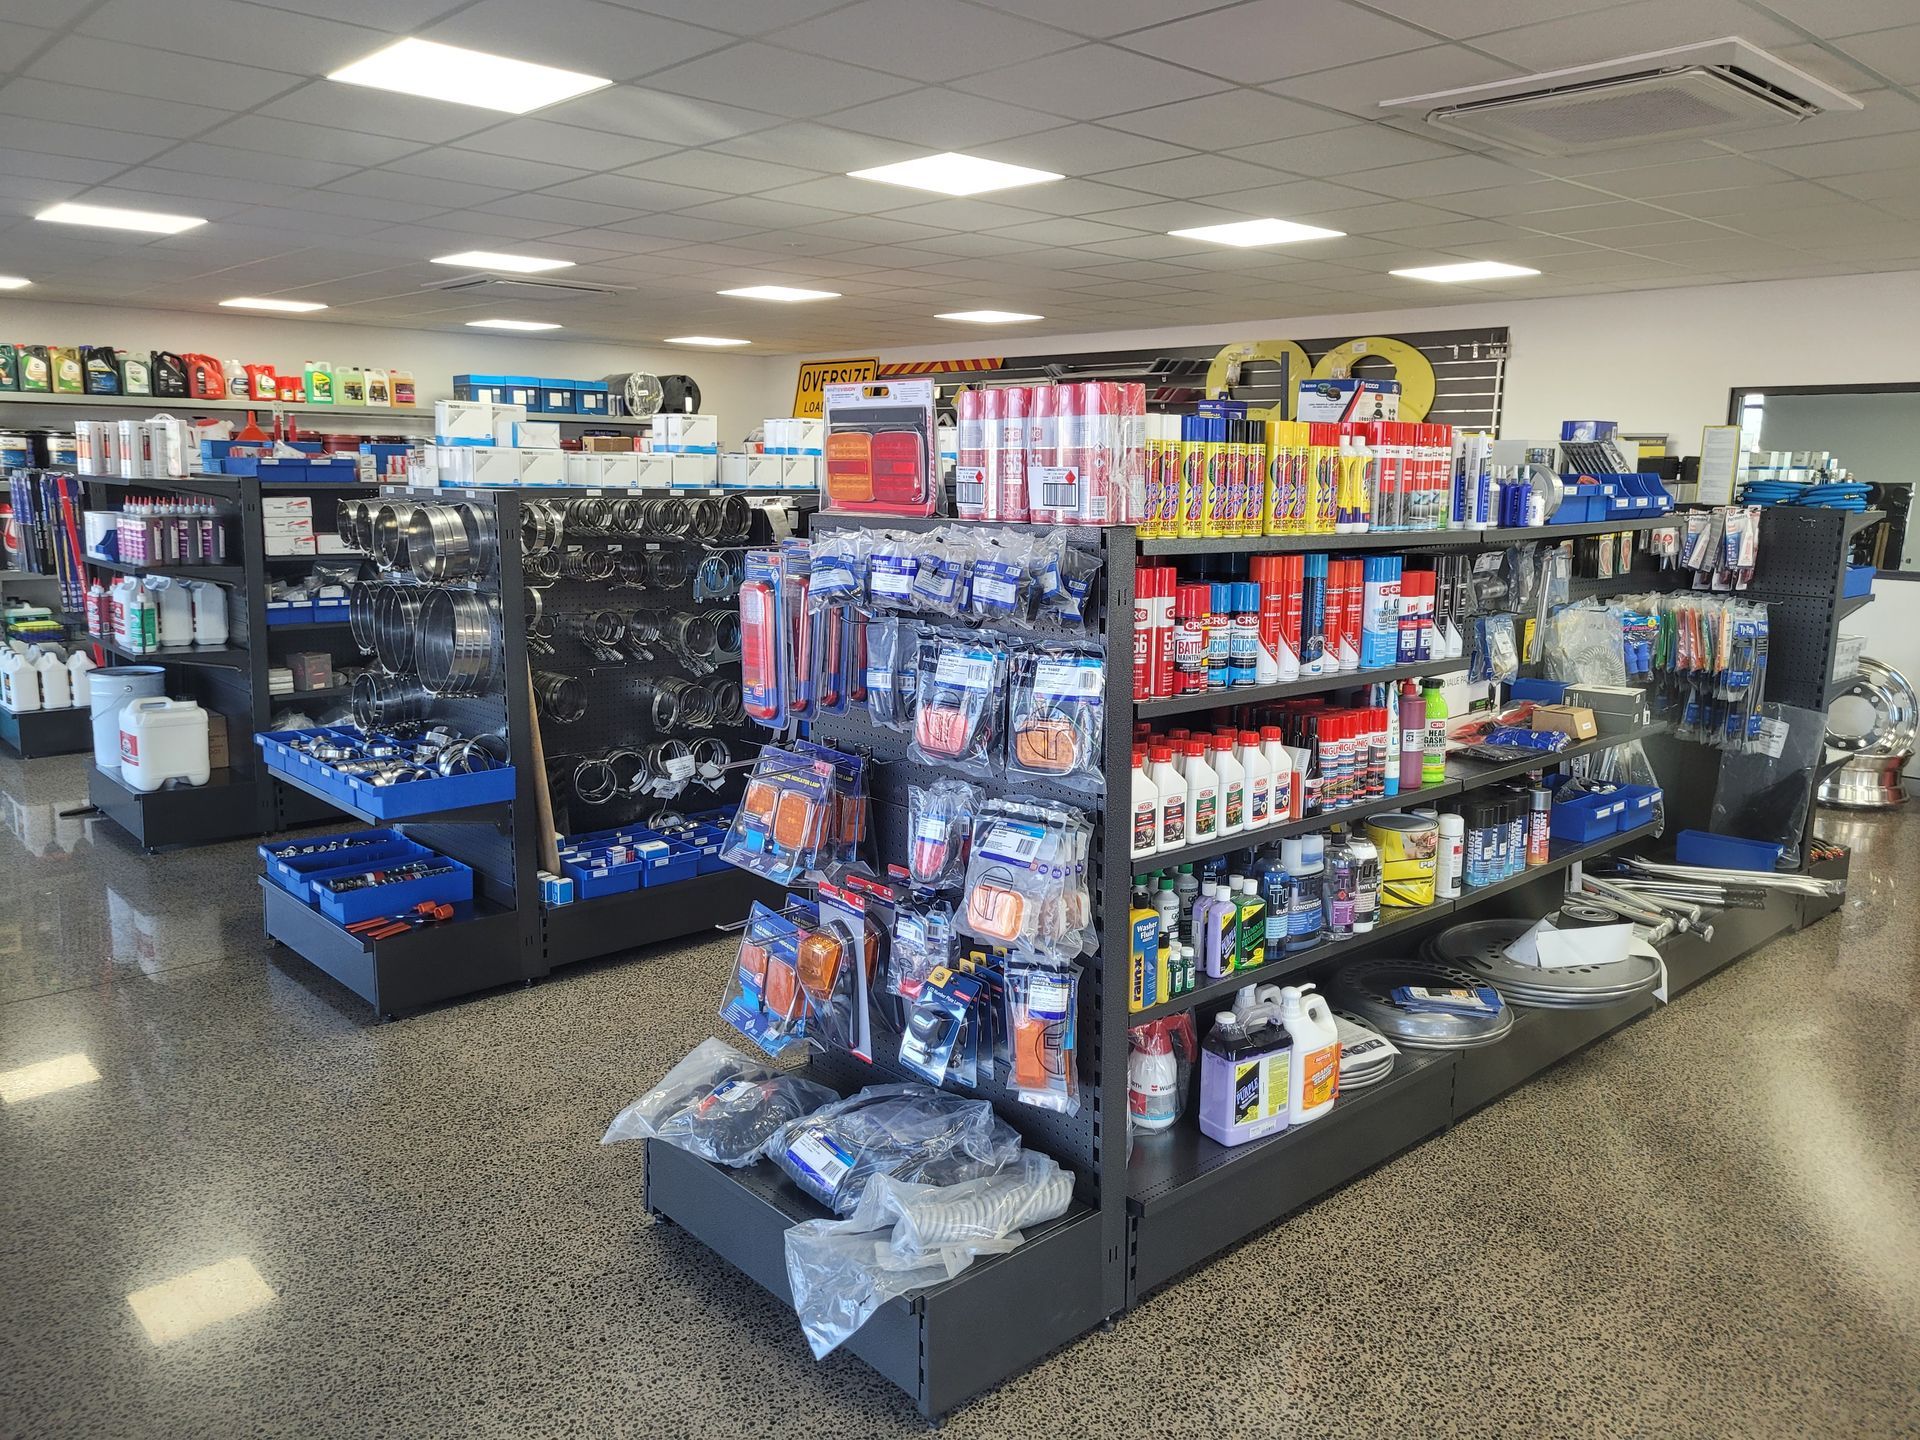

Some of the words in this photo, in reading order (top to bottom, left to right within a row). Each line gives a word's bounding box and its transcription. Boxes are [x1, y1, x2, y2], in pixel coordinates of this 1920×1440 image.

[802, 367, 871, 392] OVERSIZE
[803, 401, 824, 413] LOA
[1237, 616, 1258, 625] CRC
[1532, 812, 1542, 854] EXHAUST
[1540, 812, 1548, 841] PAINT
[1467, 828, 1476, 873] EXHAUST
[1474, 830, 1484, 861] PAINT
[1137, 921, 1158, 933] Washer
[1140, 929, 1155, 940] Fluid
[1236, 1076, 1260, 1105] PURPLE
